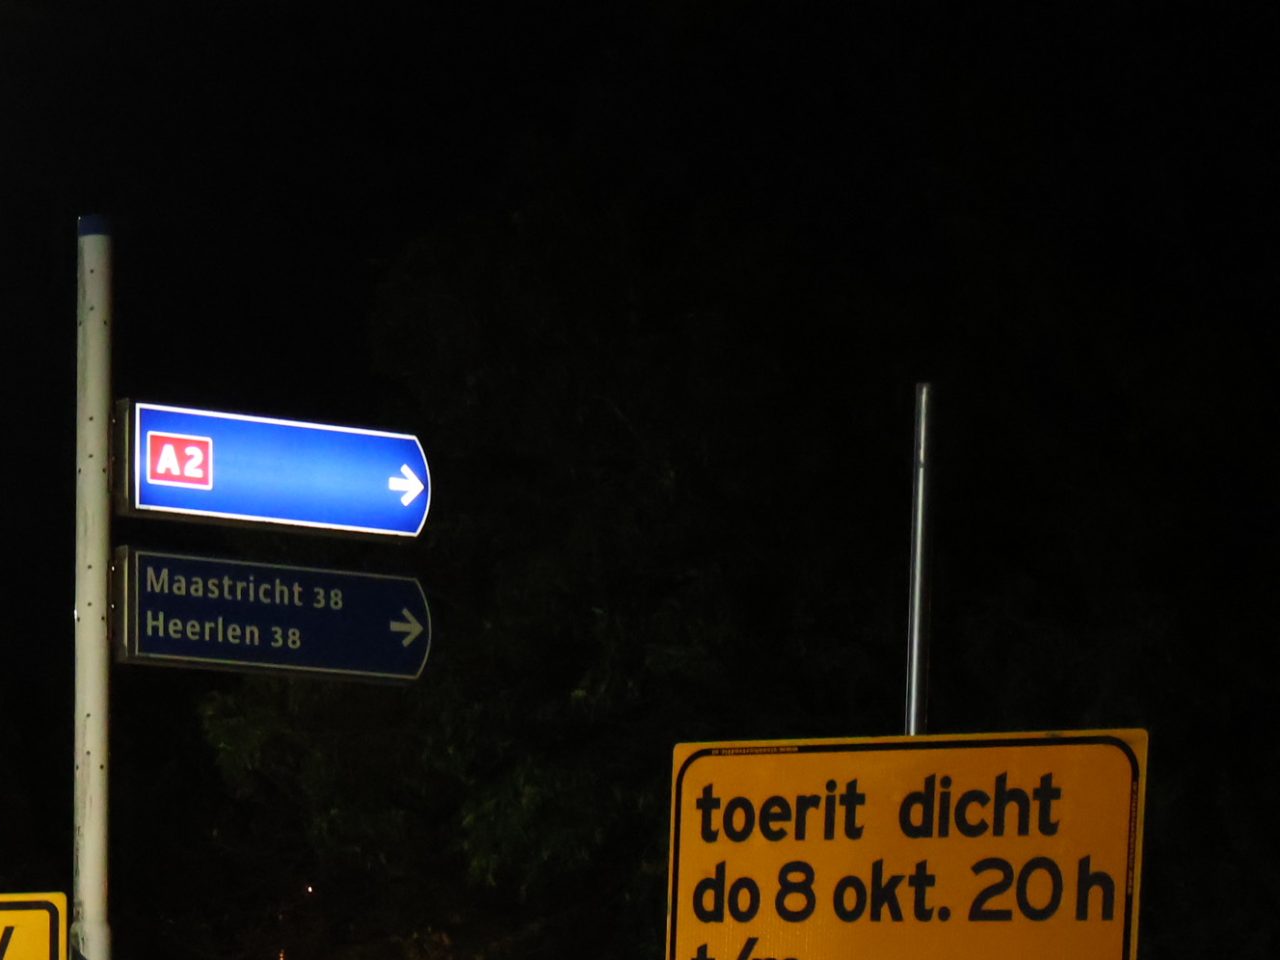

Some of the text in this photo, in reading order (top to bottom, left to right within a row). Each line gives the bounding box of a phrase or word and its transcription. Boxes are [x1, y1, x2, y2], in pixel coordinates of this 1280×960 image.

[157, 444, 204, 479] A2
[146, 566, 343, 610] Maastricht 38
[146, 610, 301, 649] Heerlen 38
[696, 777, 865, 843] toerit
[898, 771, 1061, 838] dicht
[692, 855, 1115, 923] do 8 okt. 20 h
